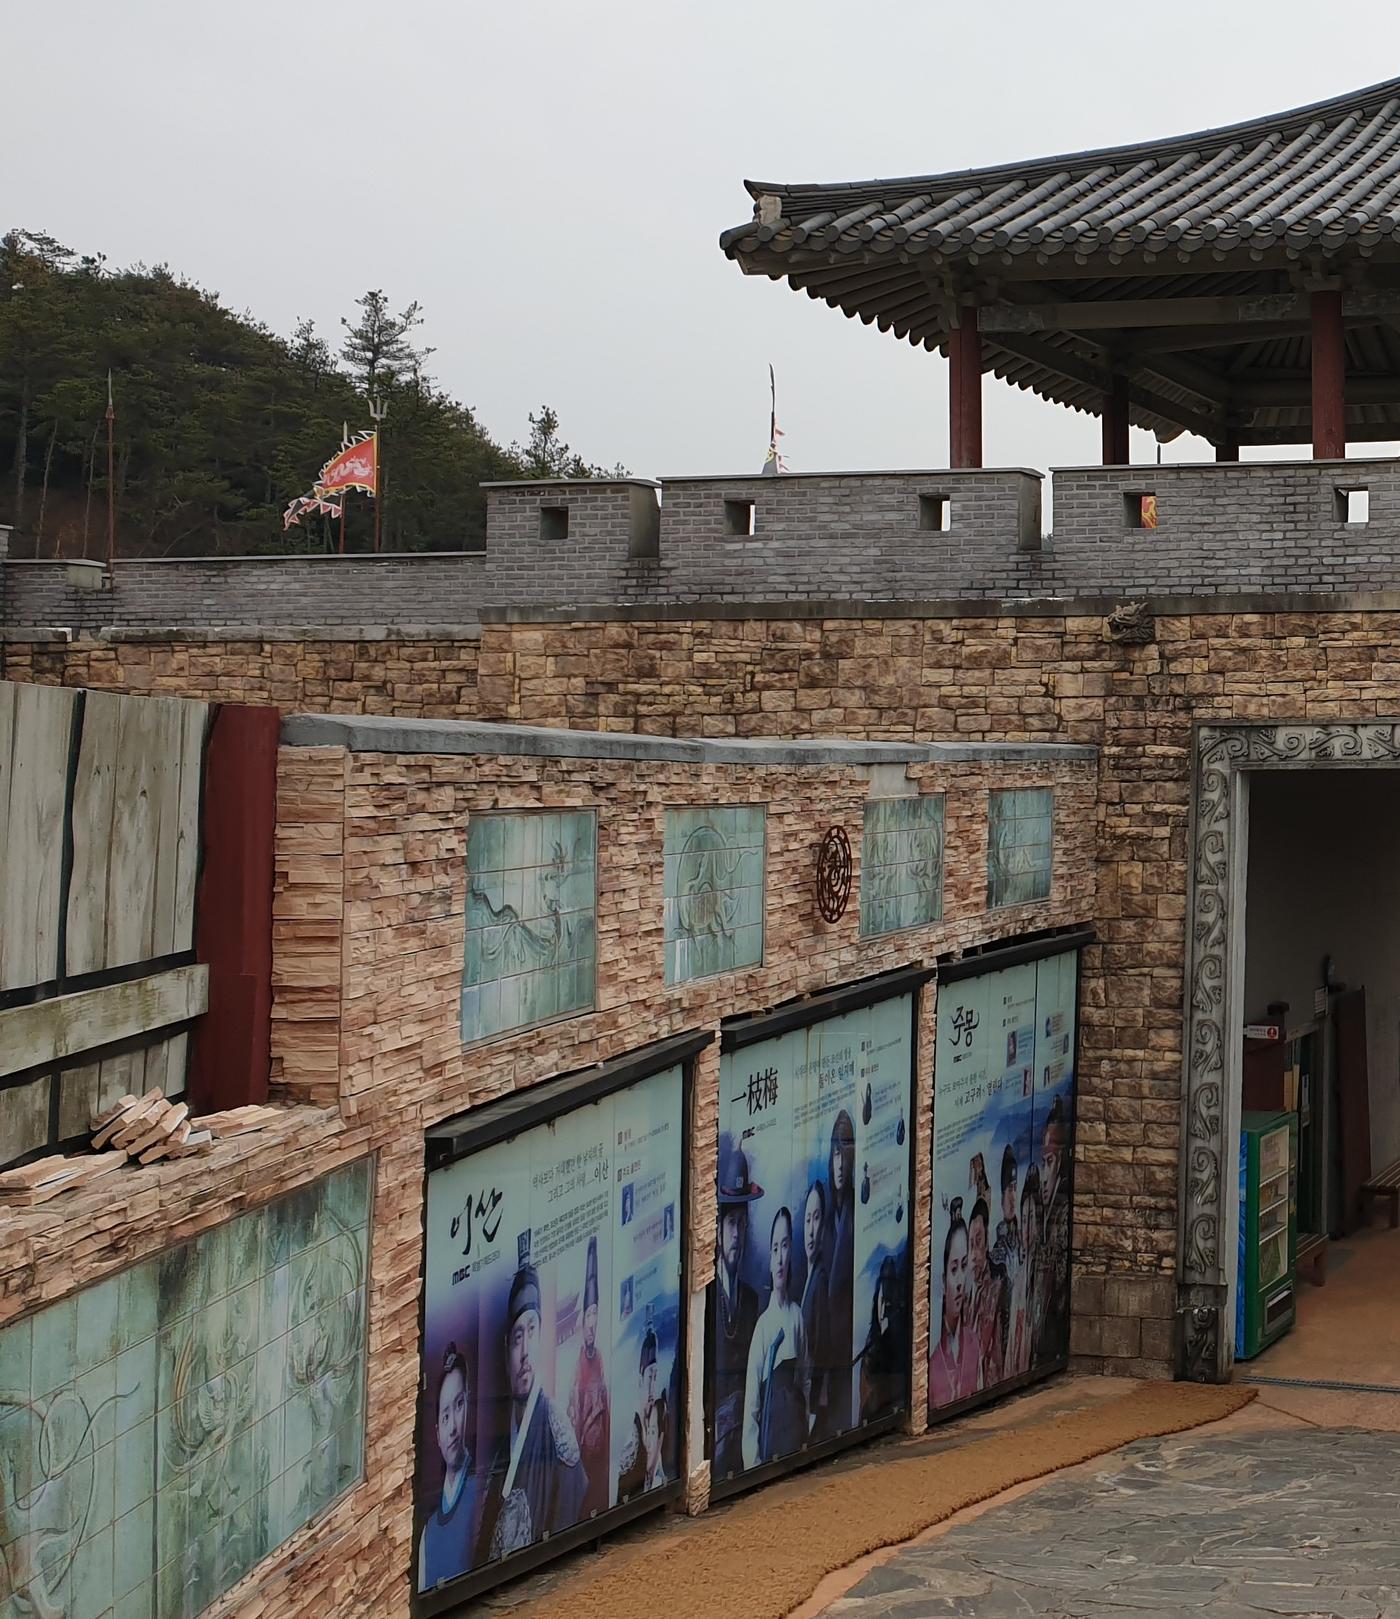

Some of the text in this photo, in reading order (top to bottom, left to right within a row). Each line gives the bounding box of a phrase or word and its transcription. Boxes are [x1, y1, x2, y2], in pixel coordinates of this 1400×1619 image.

[949, 1005, 980, 1047] 주몽
[731, 1067, 779, 1116] 一枝梅
[594, 1157, 609, 1182] 이산
[451, 1187, 503, 1255] 이산
[452, 1265, 471, 1286] MBC
